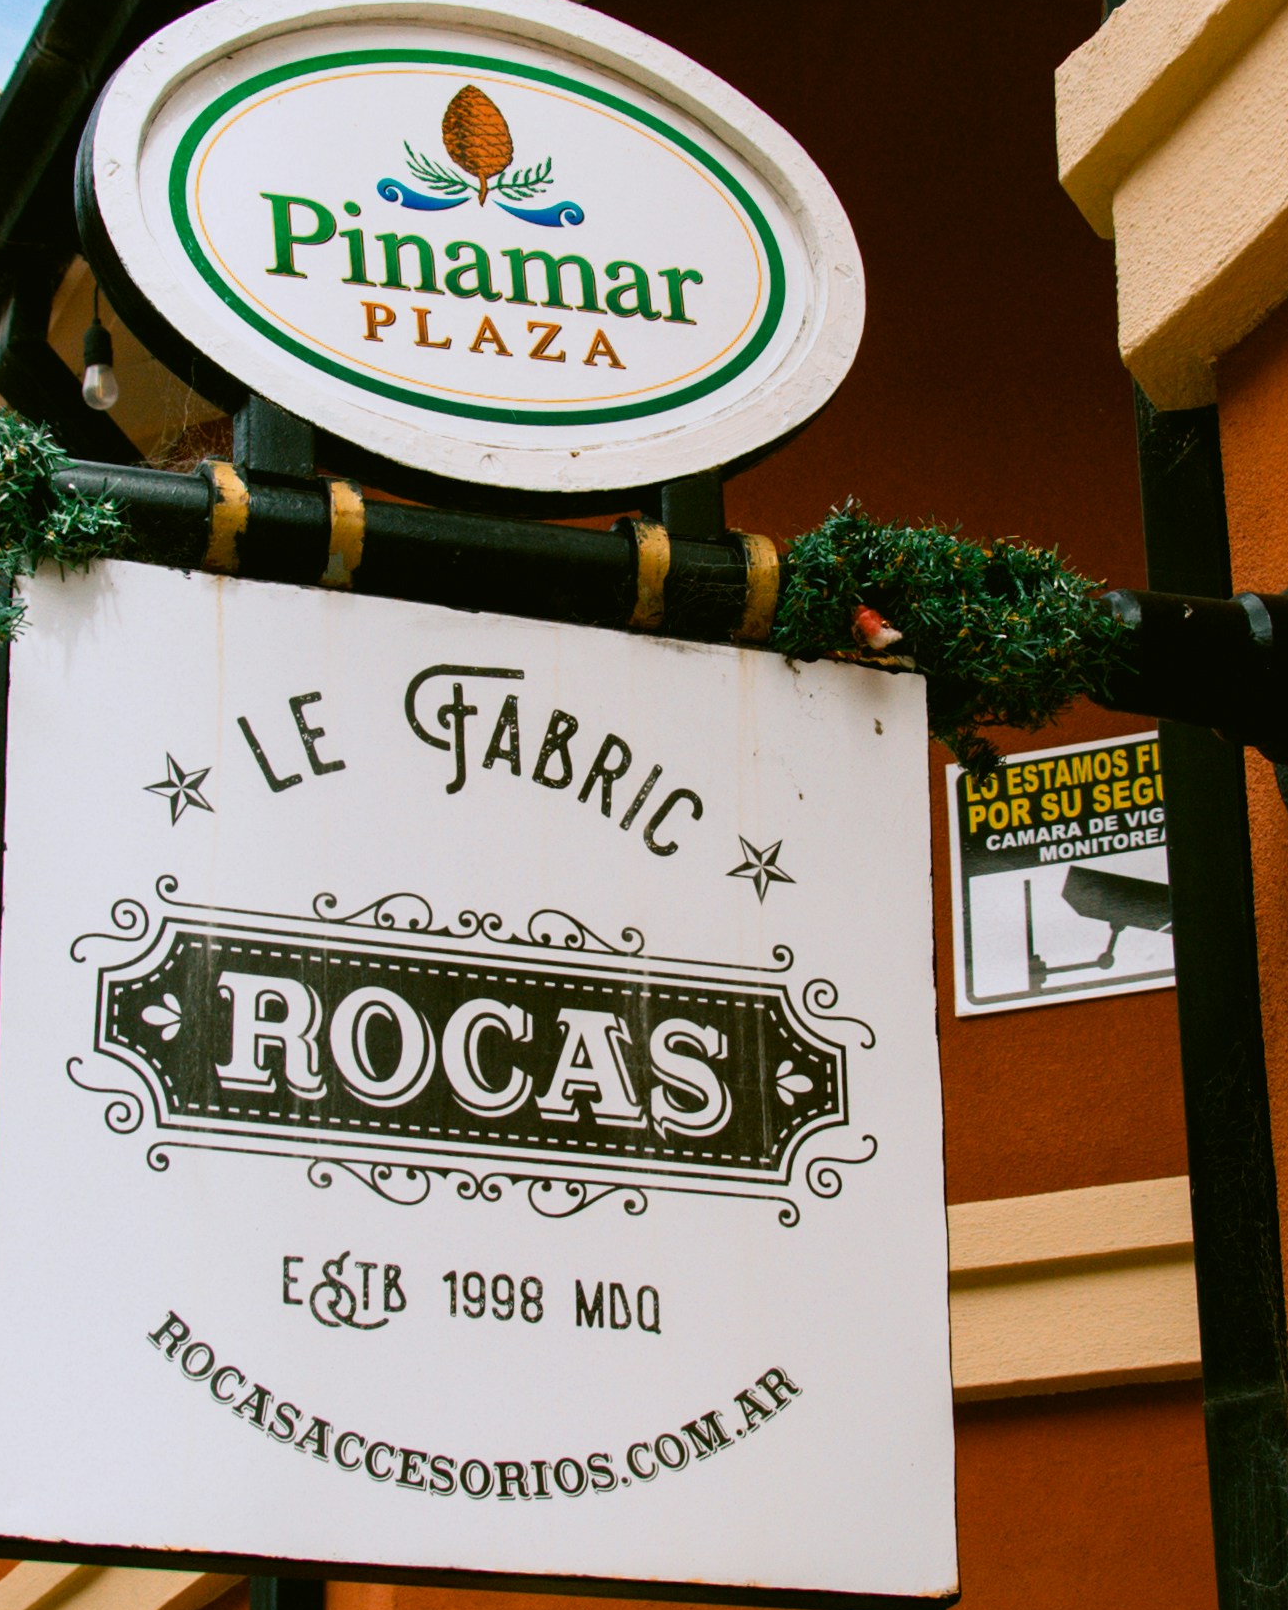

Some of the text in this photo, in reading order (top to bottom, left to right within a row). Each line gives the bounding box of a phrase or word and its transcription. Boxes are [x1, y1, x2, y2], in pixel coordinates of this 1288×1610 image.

[259, 190, 704, 326] Pinamar
[360, 301, 628, 371] PLAZA
[236, 663, 705, 857] LE FABRIC
[1007, 748, 1130, 797] ESTAMOS
[968, 796, 1034, 834] POR
[1041, 793, 1083, 822] SU
[986, 807, 1164, 852] CAMARA DE VIG
[215, 970, 734, 1140] ROCAS
[281, 1250, 663, 1335] ESTB 1998 MDQ
[146, 1310, 804, 1501] ROCASACCESORIOS.COM.AR
